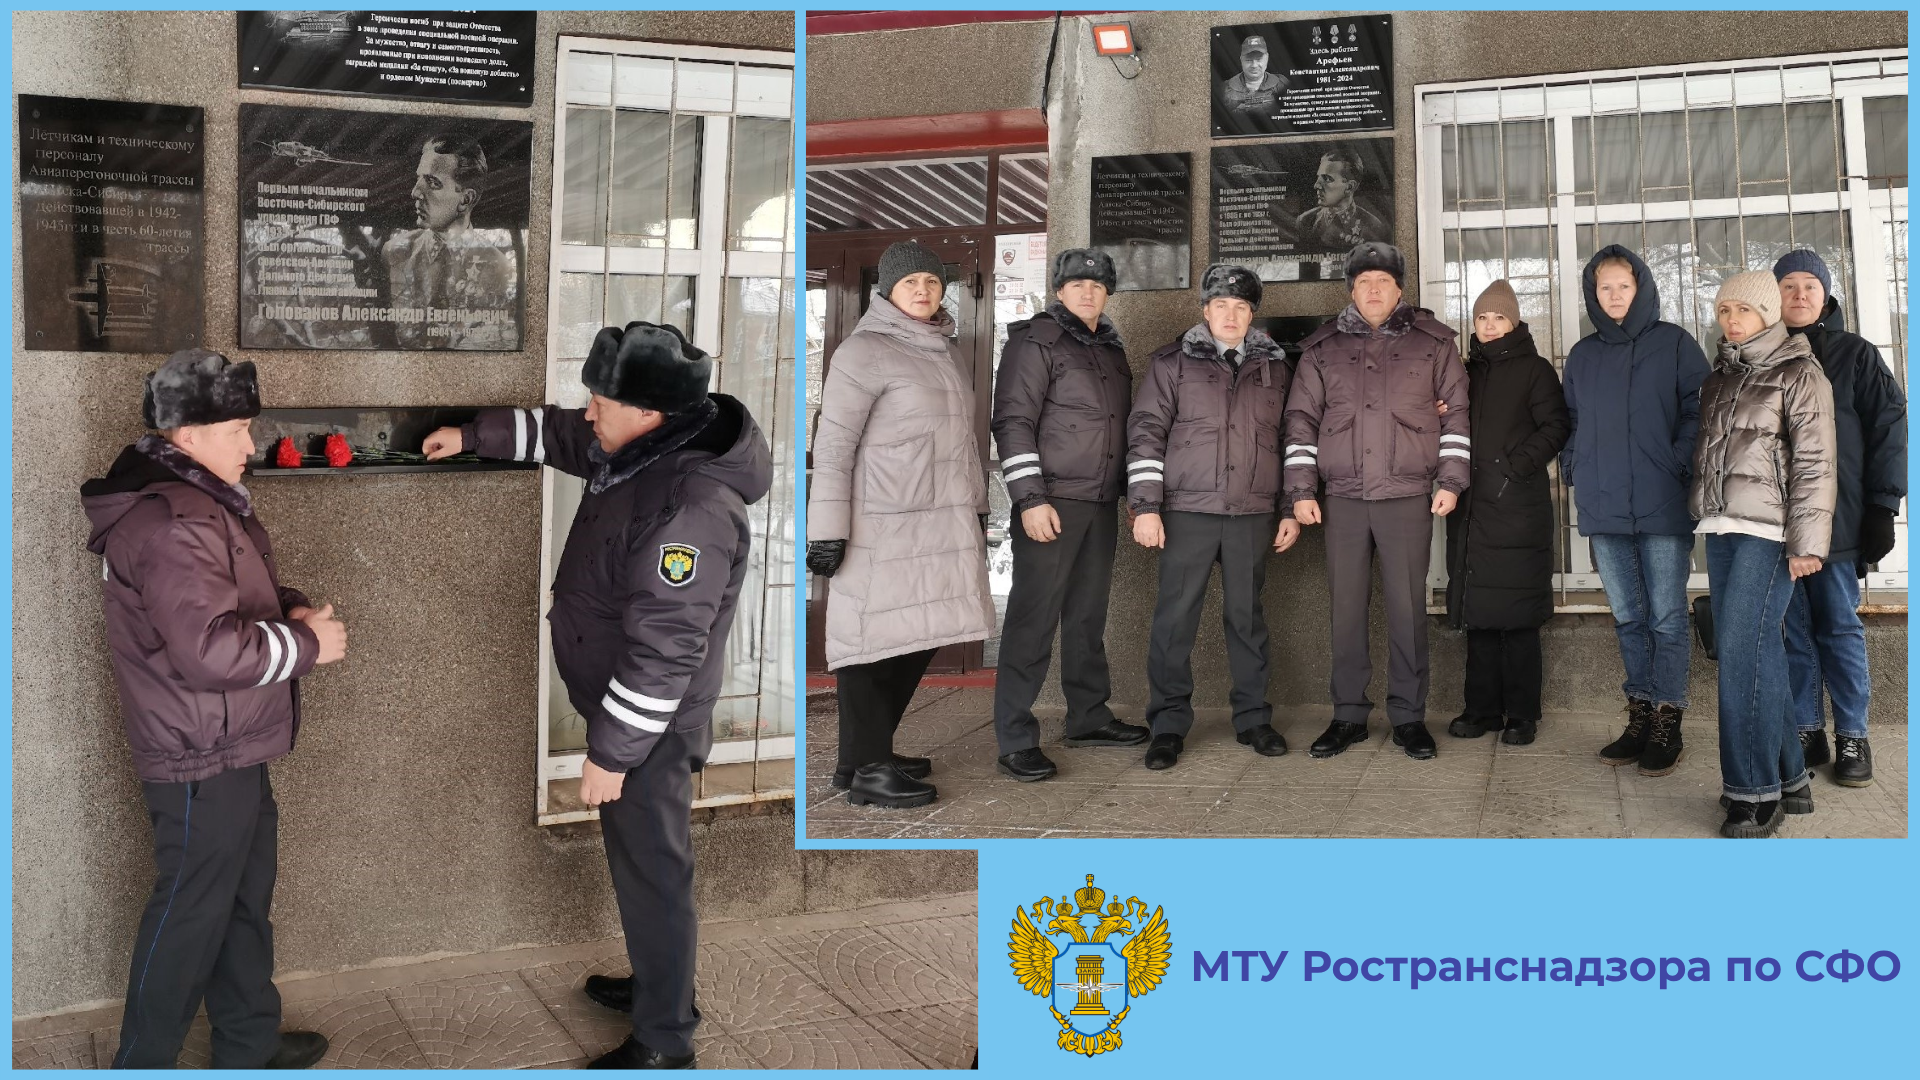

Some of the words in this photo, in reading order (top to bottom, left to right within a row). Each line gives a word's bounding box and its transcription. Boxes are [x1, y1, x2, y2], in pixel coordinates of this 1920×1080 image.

[365, 36, 374, 44] За
[403, 52, 416, 60] при
[1330, 46, 1358, 54] работал
[97, 135, 105, 144] и
[107, 136, 195, 154] техническому
[36, 149, 104, 165] персоналу
[29, 164, 148, 183] Авиаперегоночной
[151, 174, 194, 186] трассы
[258, 181, 299, 194] Первым
[300, 185, 369, 198] начальником
[257, 196, 366, 212] Восточно-Сибирского
[138, 208, 144, 217] в
[319, 214, 340, 225] ГВФ
[80, 224, 88, 233] и
[92, 225, 99, 233] в
[103, 225, 137, 236] честь
[140, 225, 192, 239] 60-летия
[146, 243, 190, 255] трассы
[257, 302, 340, 321] Голованов
[342, 304, 425, 324] Александр
